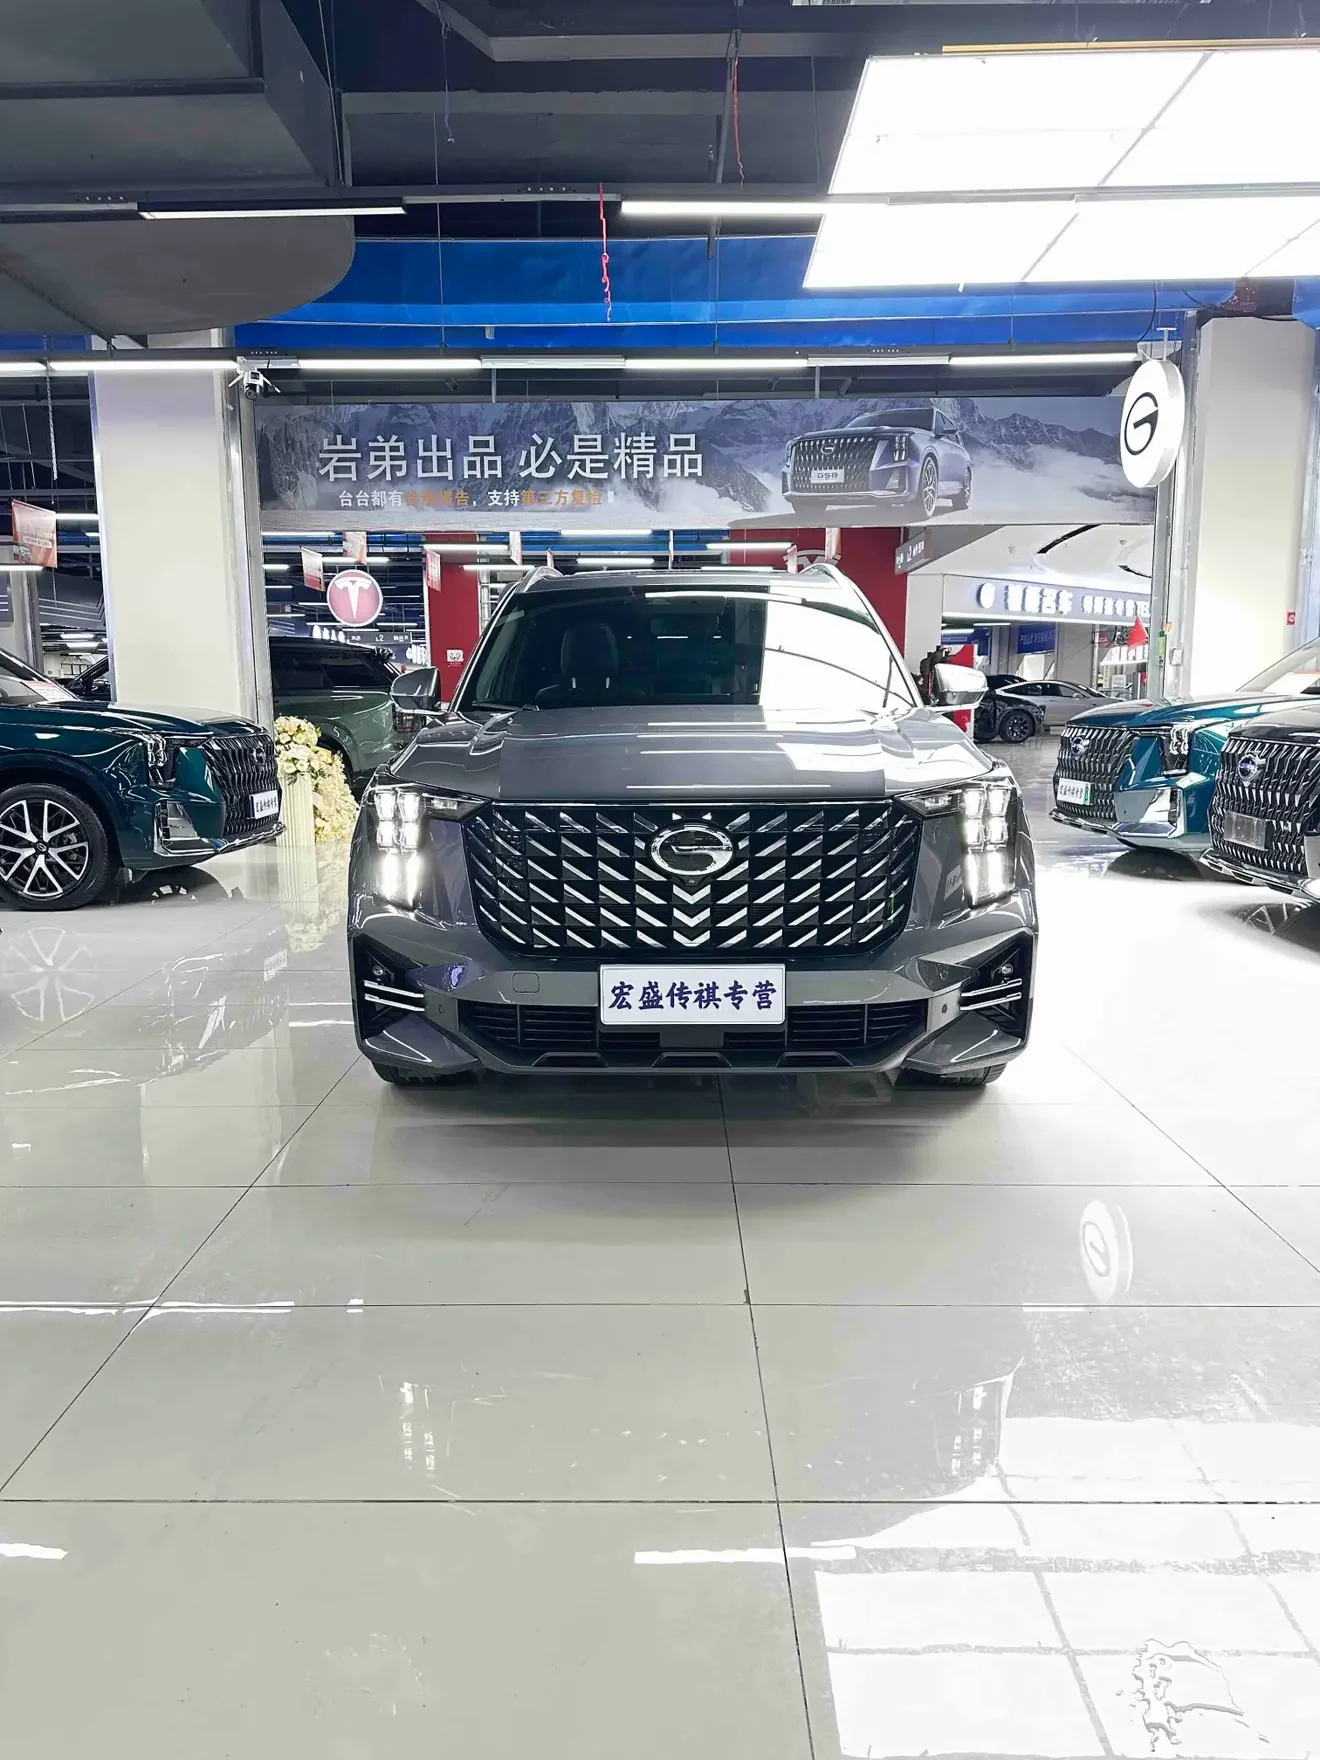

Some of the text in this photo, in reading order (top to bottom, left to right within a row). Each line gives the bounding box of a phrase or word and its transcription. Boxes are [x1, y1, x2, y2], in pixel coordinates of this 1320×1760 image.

[318, 432, 703, 482] 岩弟出品 必是精品
[608, 980, 777, 1010] 宏盛传祺专营
